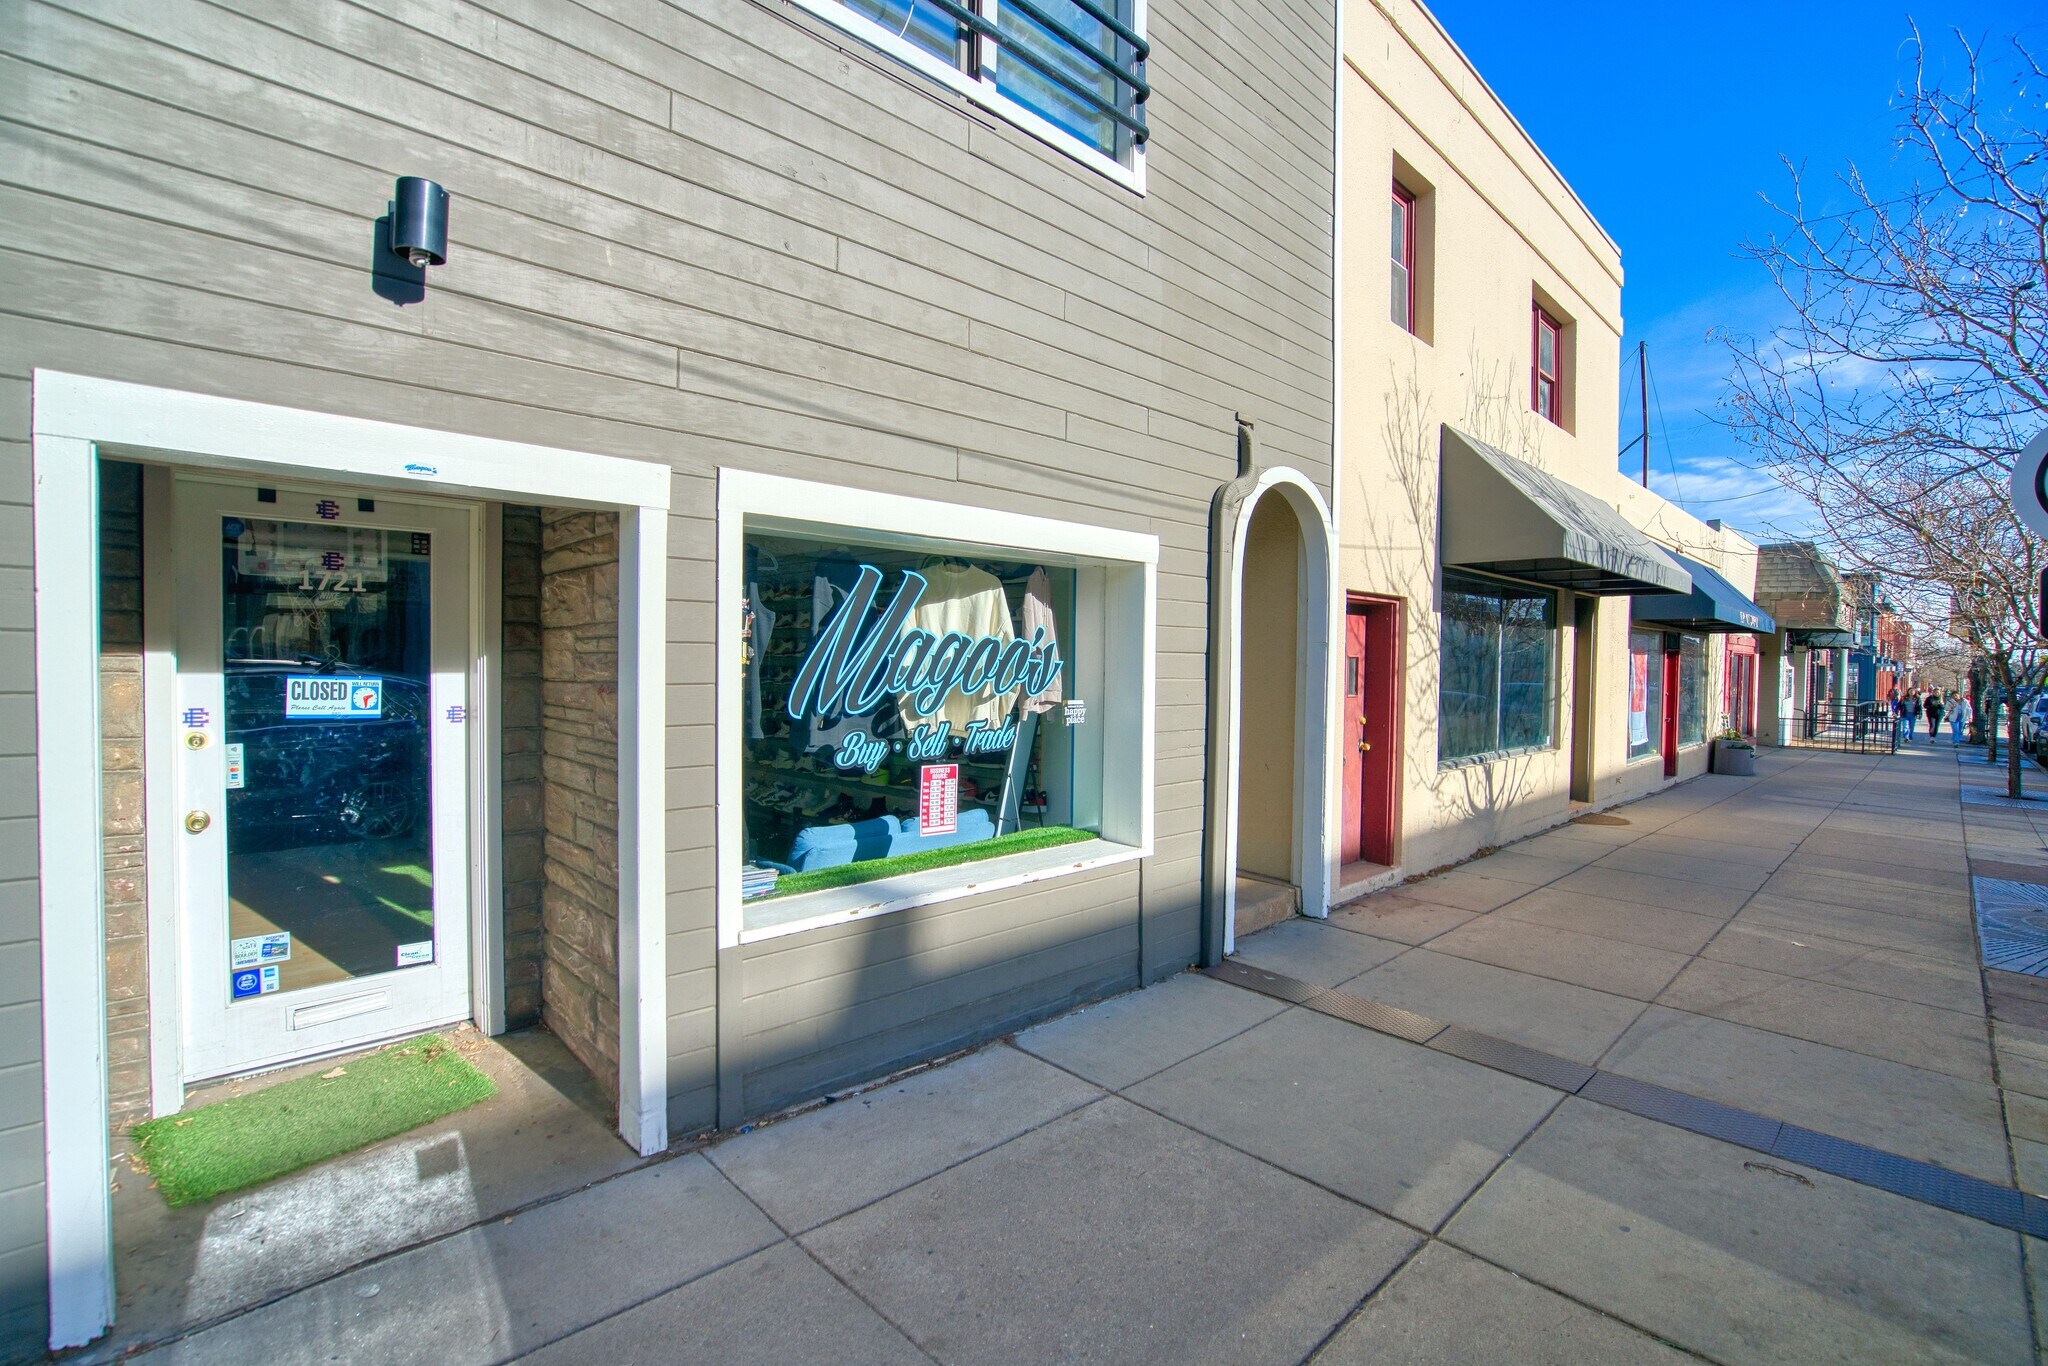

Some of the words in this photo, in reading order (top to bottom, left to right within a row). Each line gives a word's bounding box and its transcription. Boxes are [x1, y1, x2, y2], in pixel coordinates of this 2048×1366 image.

[299, 570, 367, 592] 1721
[319, 591, 340, 600] NIKE
[788, 564, 1065, 720] Magoo's
[291, 681, 348, 701] CLOSED
[312, 703, 326, 711] Call
[328, 704, 346, 712] Again
[1064, 707, 1087, 717] happy
[1066, 716, 1085, 727] place
[835, 731, 889, 774] Buy
[909, 723, 949, 760] Sell
[964, 715, 1015, 754] Trade
